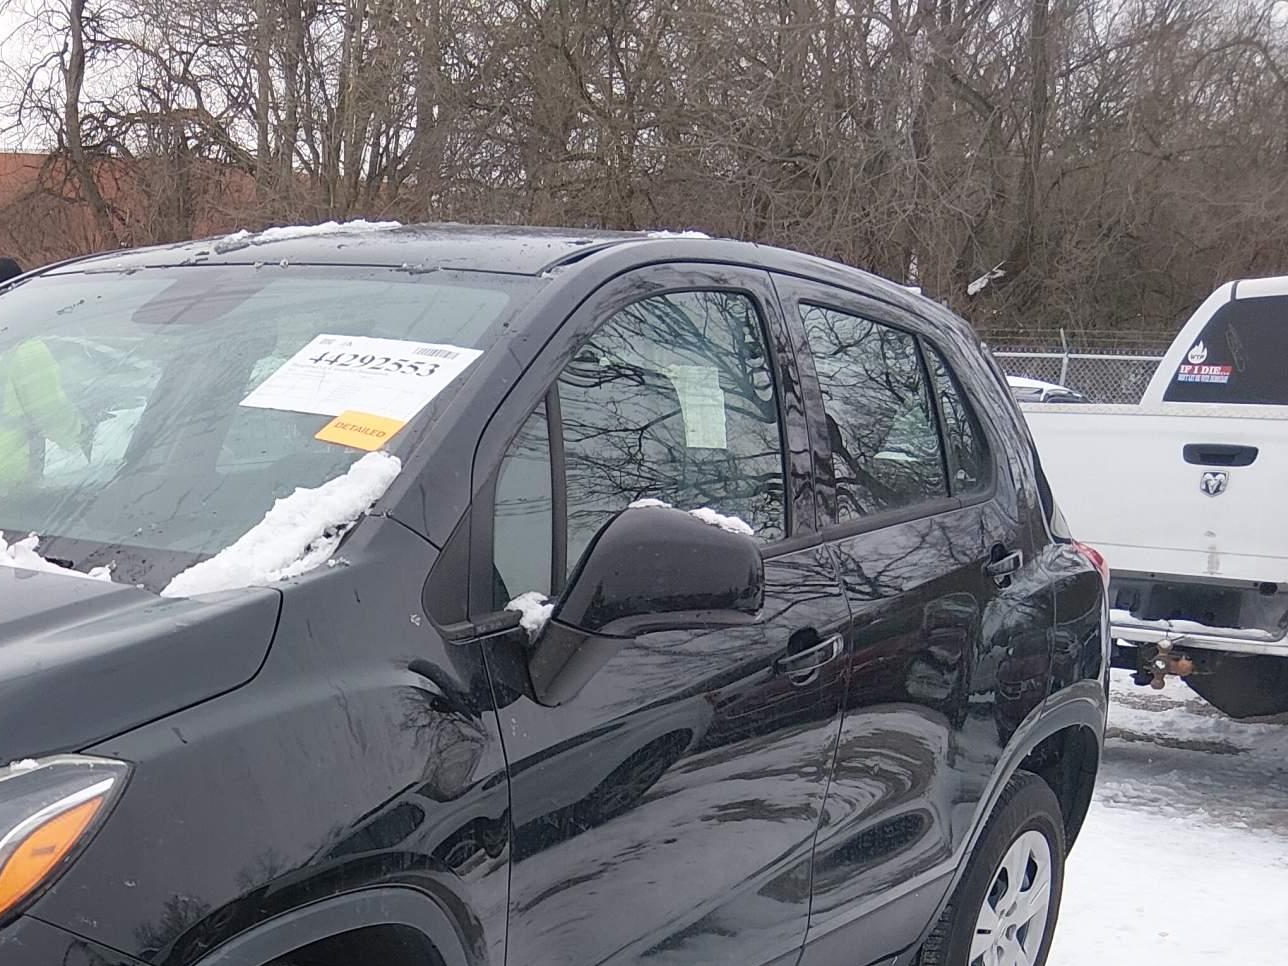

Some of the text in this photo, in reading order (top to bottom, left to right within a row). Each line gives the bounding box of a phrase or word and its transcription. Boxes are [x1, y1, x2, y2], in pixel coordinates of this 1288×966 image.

[308, 351, 441, 377] 44292553
[1193, 364, 1200, 374] I
[334, 421, 387, 438] DETAILED
